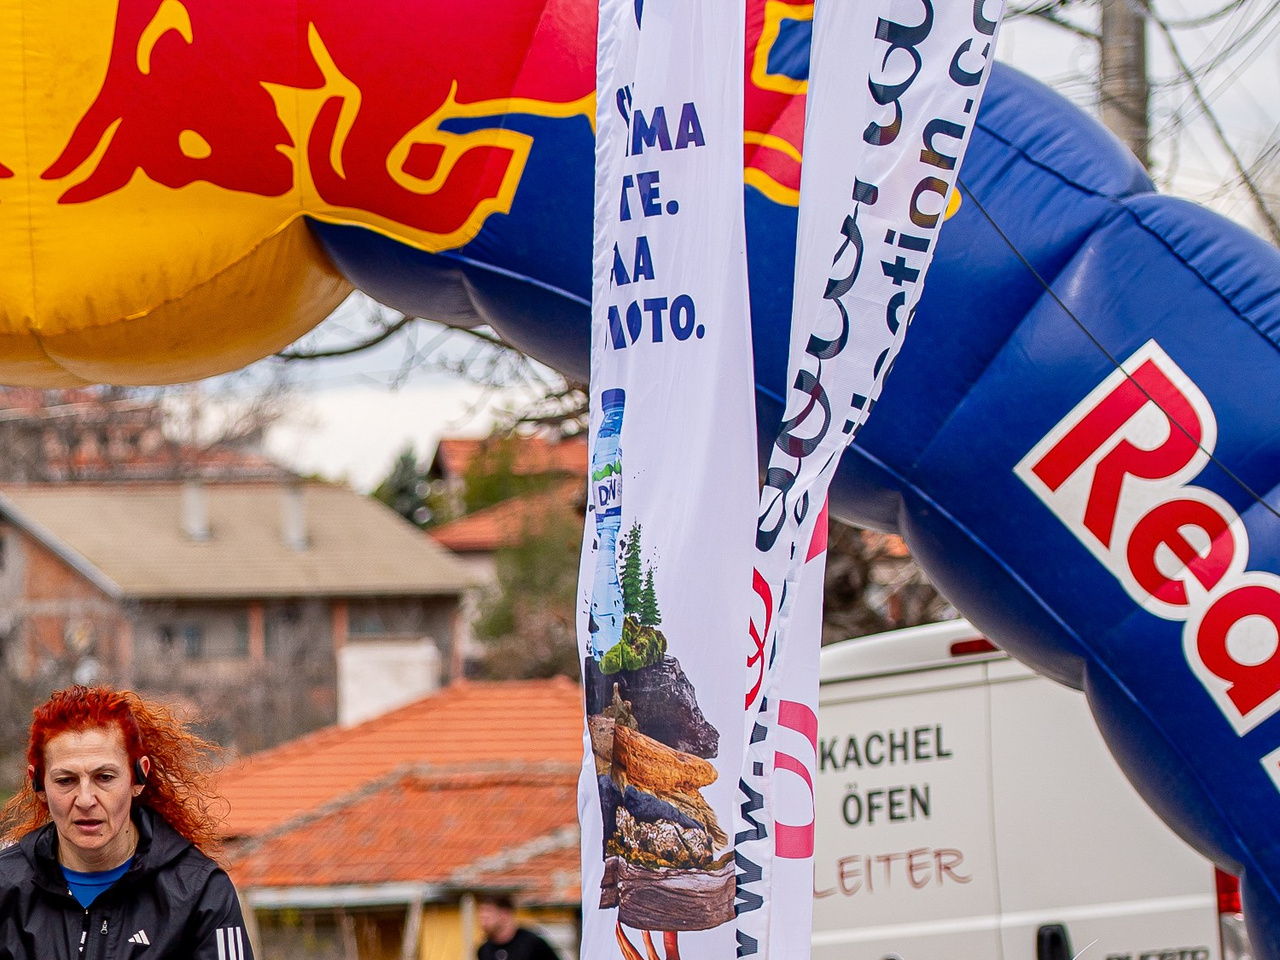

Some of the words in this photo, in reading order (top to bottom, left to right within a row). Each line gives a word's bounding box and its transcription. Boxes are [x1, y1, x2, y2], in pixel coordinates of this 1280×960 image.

[819, 723, 953, 772] KACHEL
[842, 783, 931, 826] ÖFEN
[813, 847, 972, 899] LEITER
